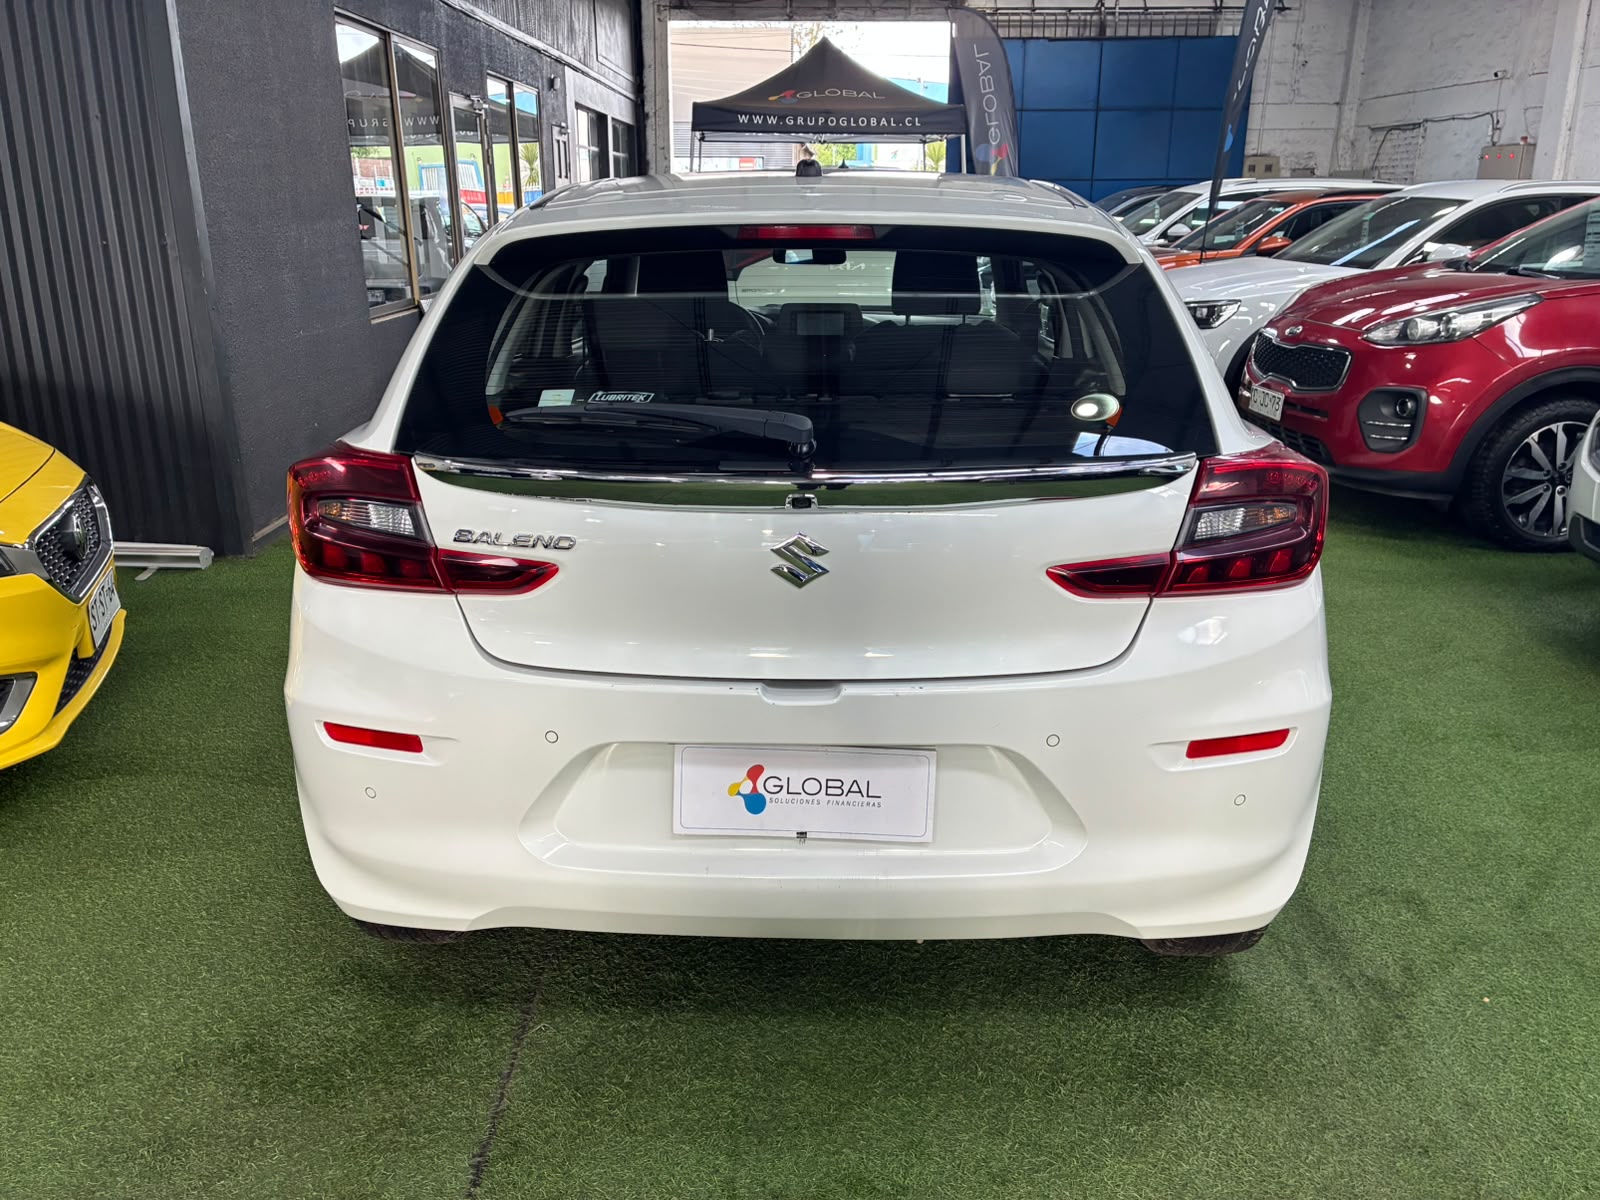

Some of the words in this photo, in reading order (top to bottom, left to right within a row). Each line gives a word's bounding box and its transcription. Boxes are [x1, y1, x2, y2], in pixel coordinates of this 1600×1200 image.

[796, 88, 885, 99] GLOBAL
[738, 114, 921, 127] WWW.GRUPOGLOBAL.CL
[596, 392, 648, 402] LUBRITEK
[453, 528, 577, 549] BALENO
[763, 776, 882, 798] GLOBAL
[769, 797, 820, 806] SOLUCIONES
[827, 799, 881, 808] FINANCIERAS
